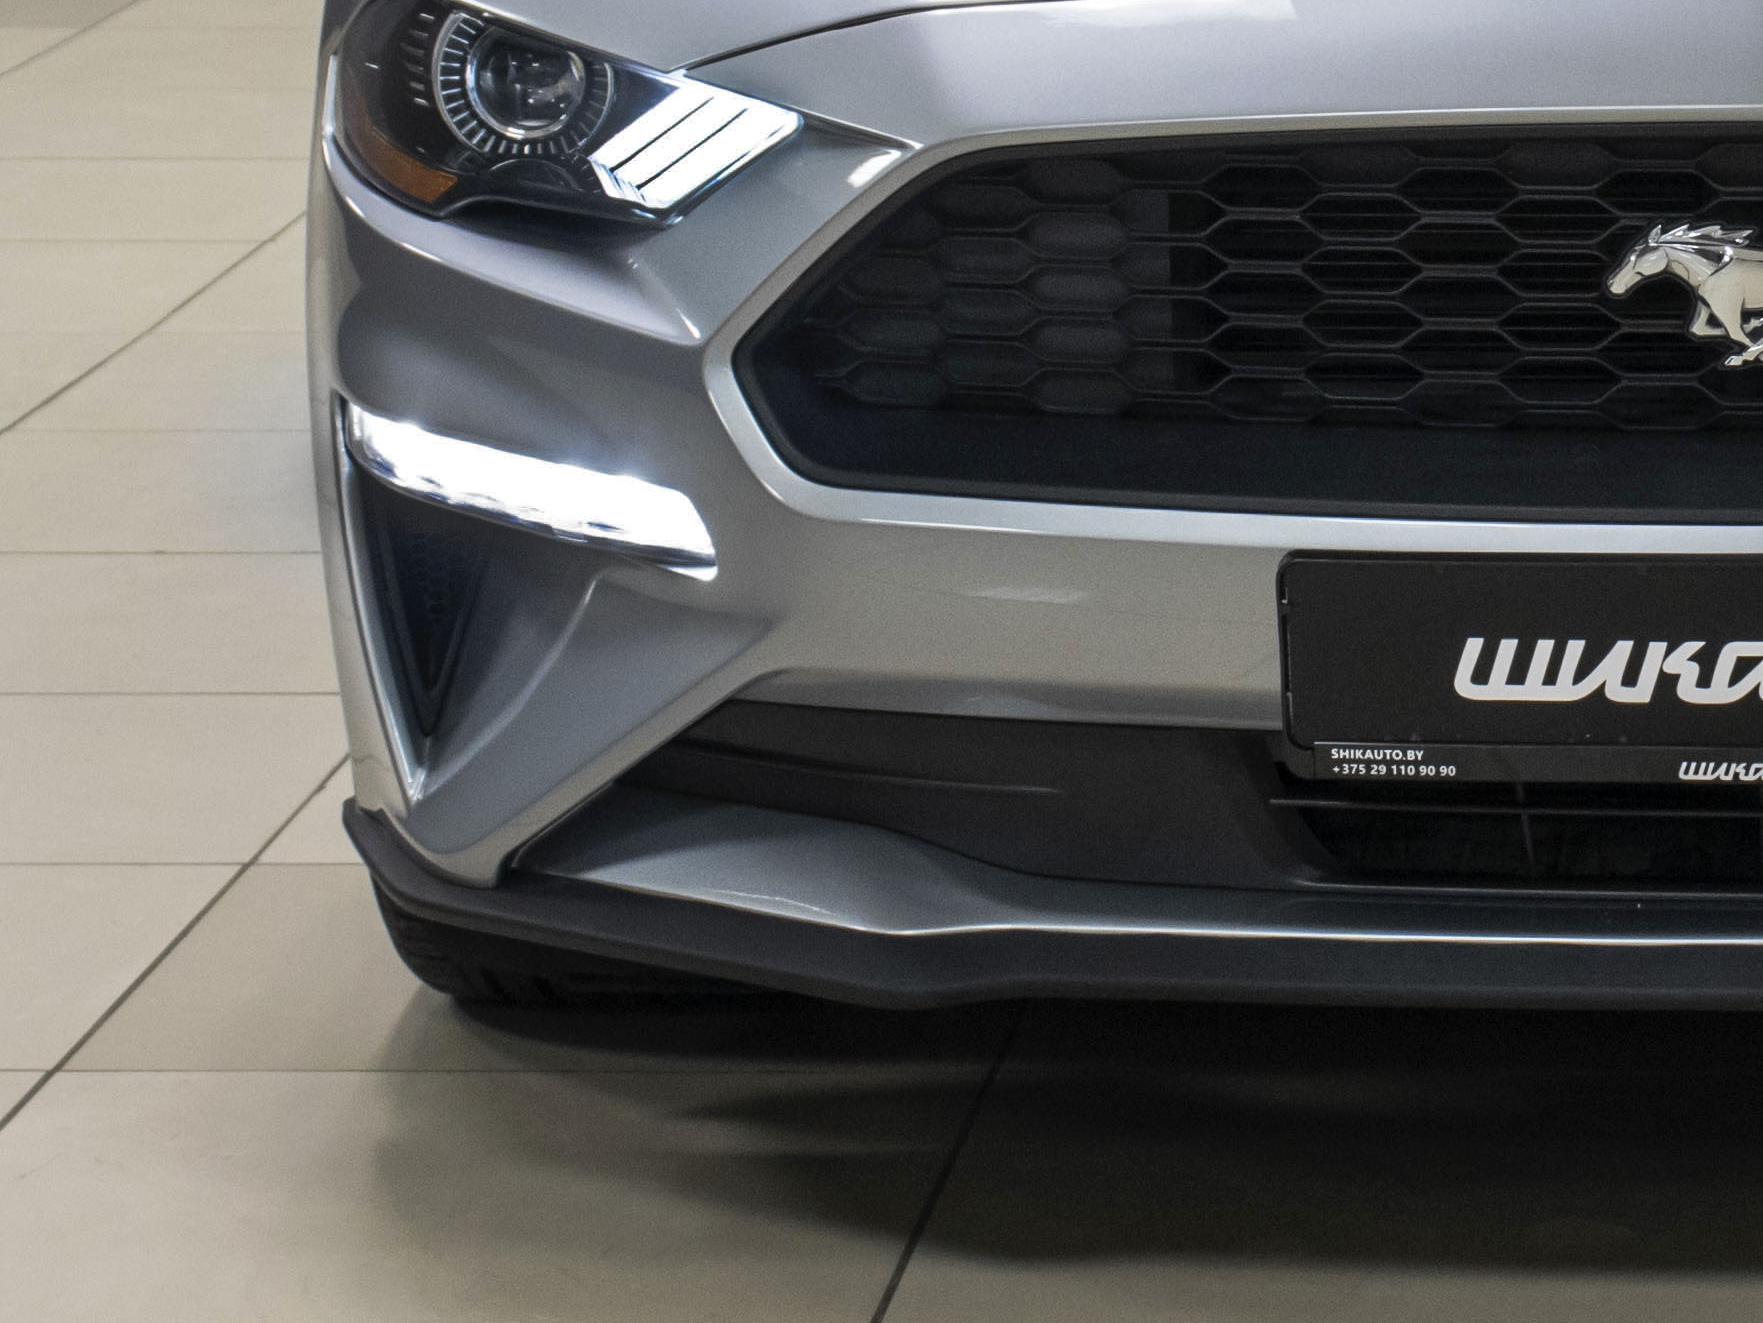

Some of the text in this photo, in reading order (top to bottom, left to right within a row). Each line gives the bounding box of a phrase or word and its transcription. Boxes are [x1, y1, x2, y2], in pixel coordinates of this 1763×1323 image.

[1331, 748, 1424, 761] SHIKAUTO.BY
[1332, 763, 1457, 777] +375 29 110 90 90
